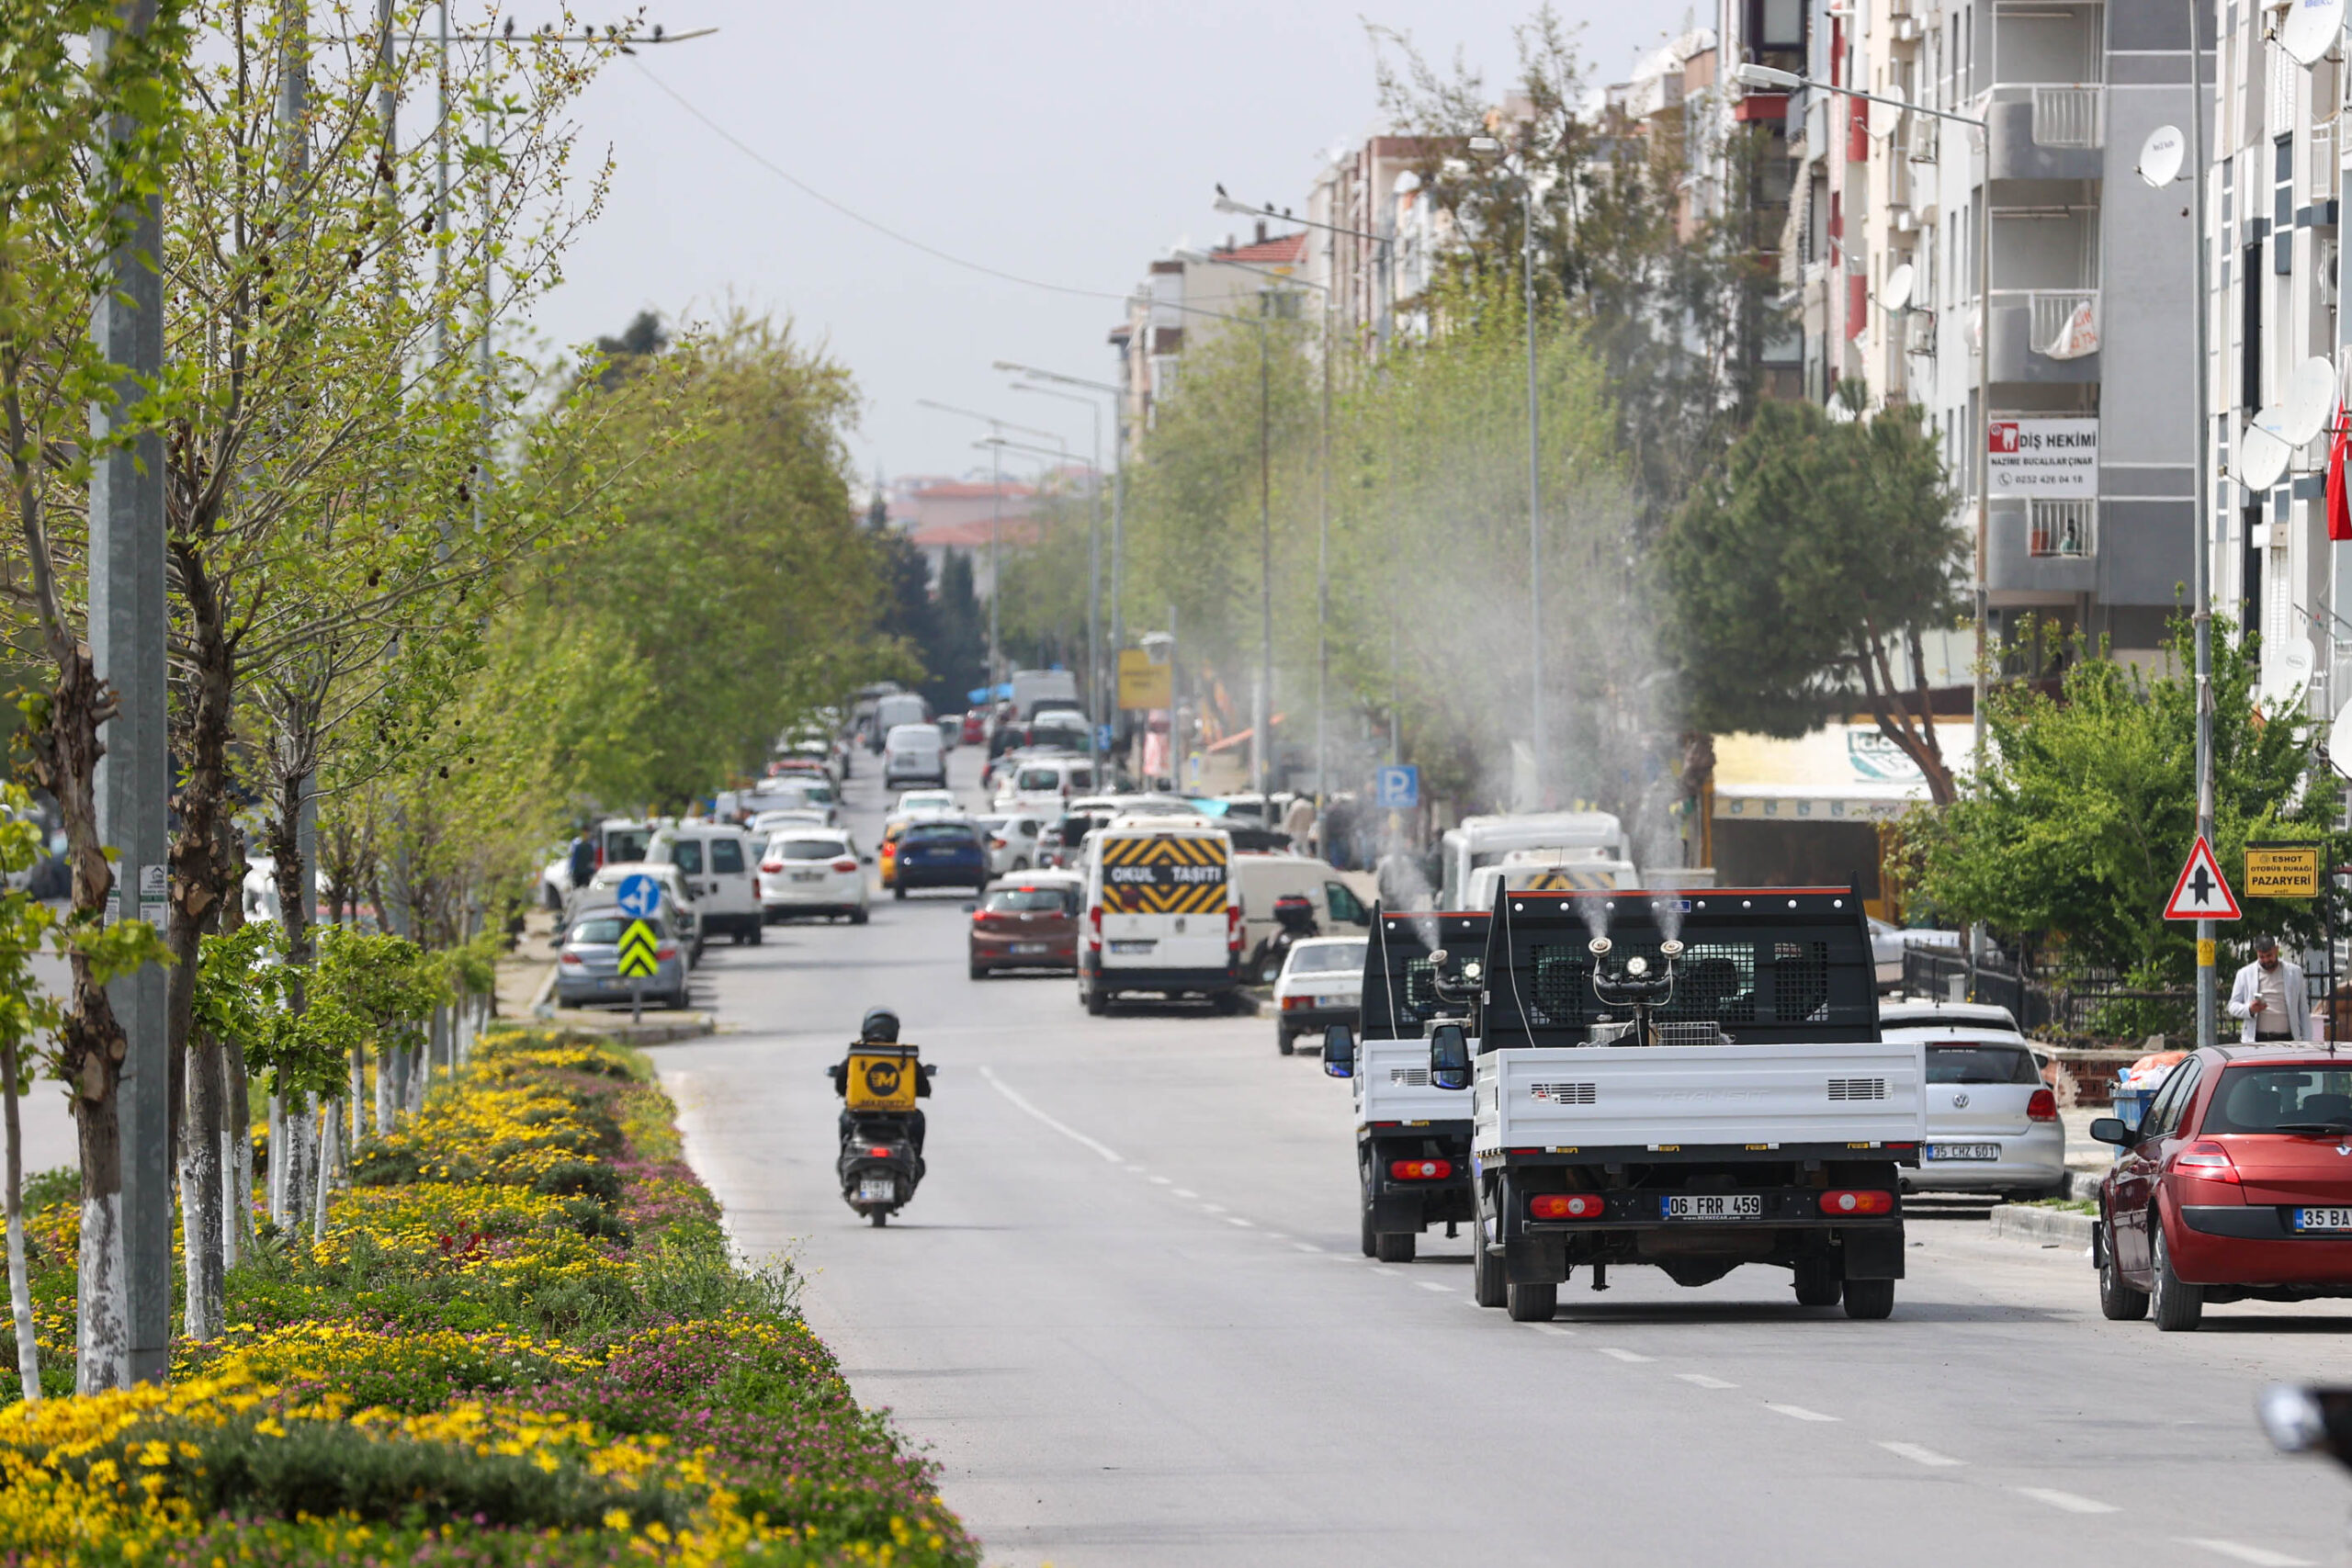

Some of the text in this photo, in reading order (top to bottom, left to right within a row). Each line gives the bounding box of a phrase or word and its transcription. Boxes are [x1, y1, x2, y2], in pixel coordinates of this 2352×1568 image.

[2019, 430, 2097, 450] DİŞ HEKİMİ
[1991, 457, 2020, 466] NAZİME
[2067, 457, 2093, 468] ÇINAR
[2016, 475, 2037, 483] 0232
[2059, 475, 2070, 483] 04
[1385, 771, 1409, 803] P
[1111, 866, 1222, 884] OKUL TAŞITI
[2252, 874, 2311, 886] PAZARYERİ
[1934, 1145, 1995, 1157] 35 CHZ 601
[1670, 1198, 1688, 1213] 06
[1697, 1197, 1724, 1213] FRR
[1733, 1196, 1759, 1213] 459
[2304, 1210, 2324, 1226] 35
[2330, 1210, 2350, 1226] BA
